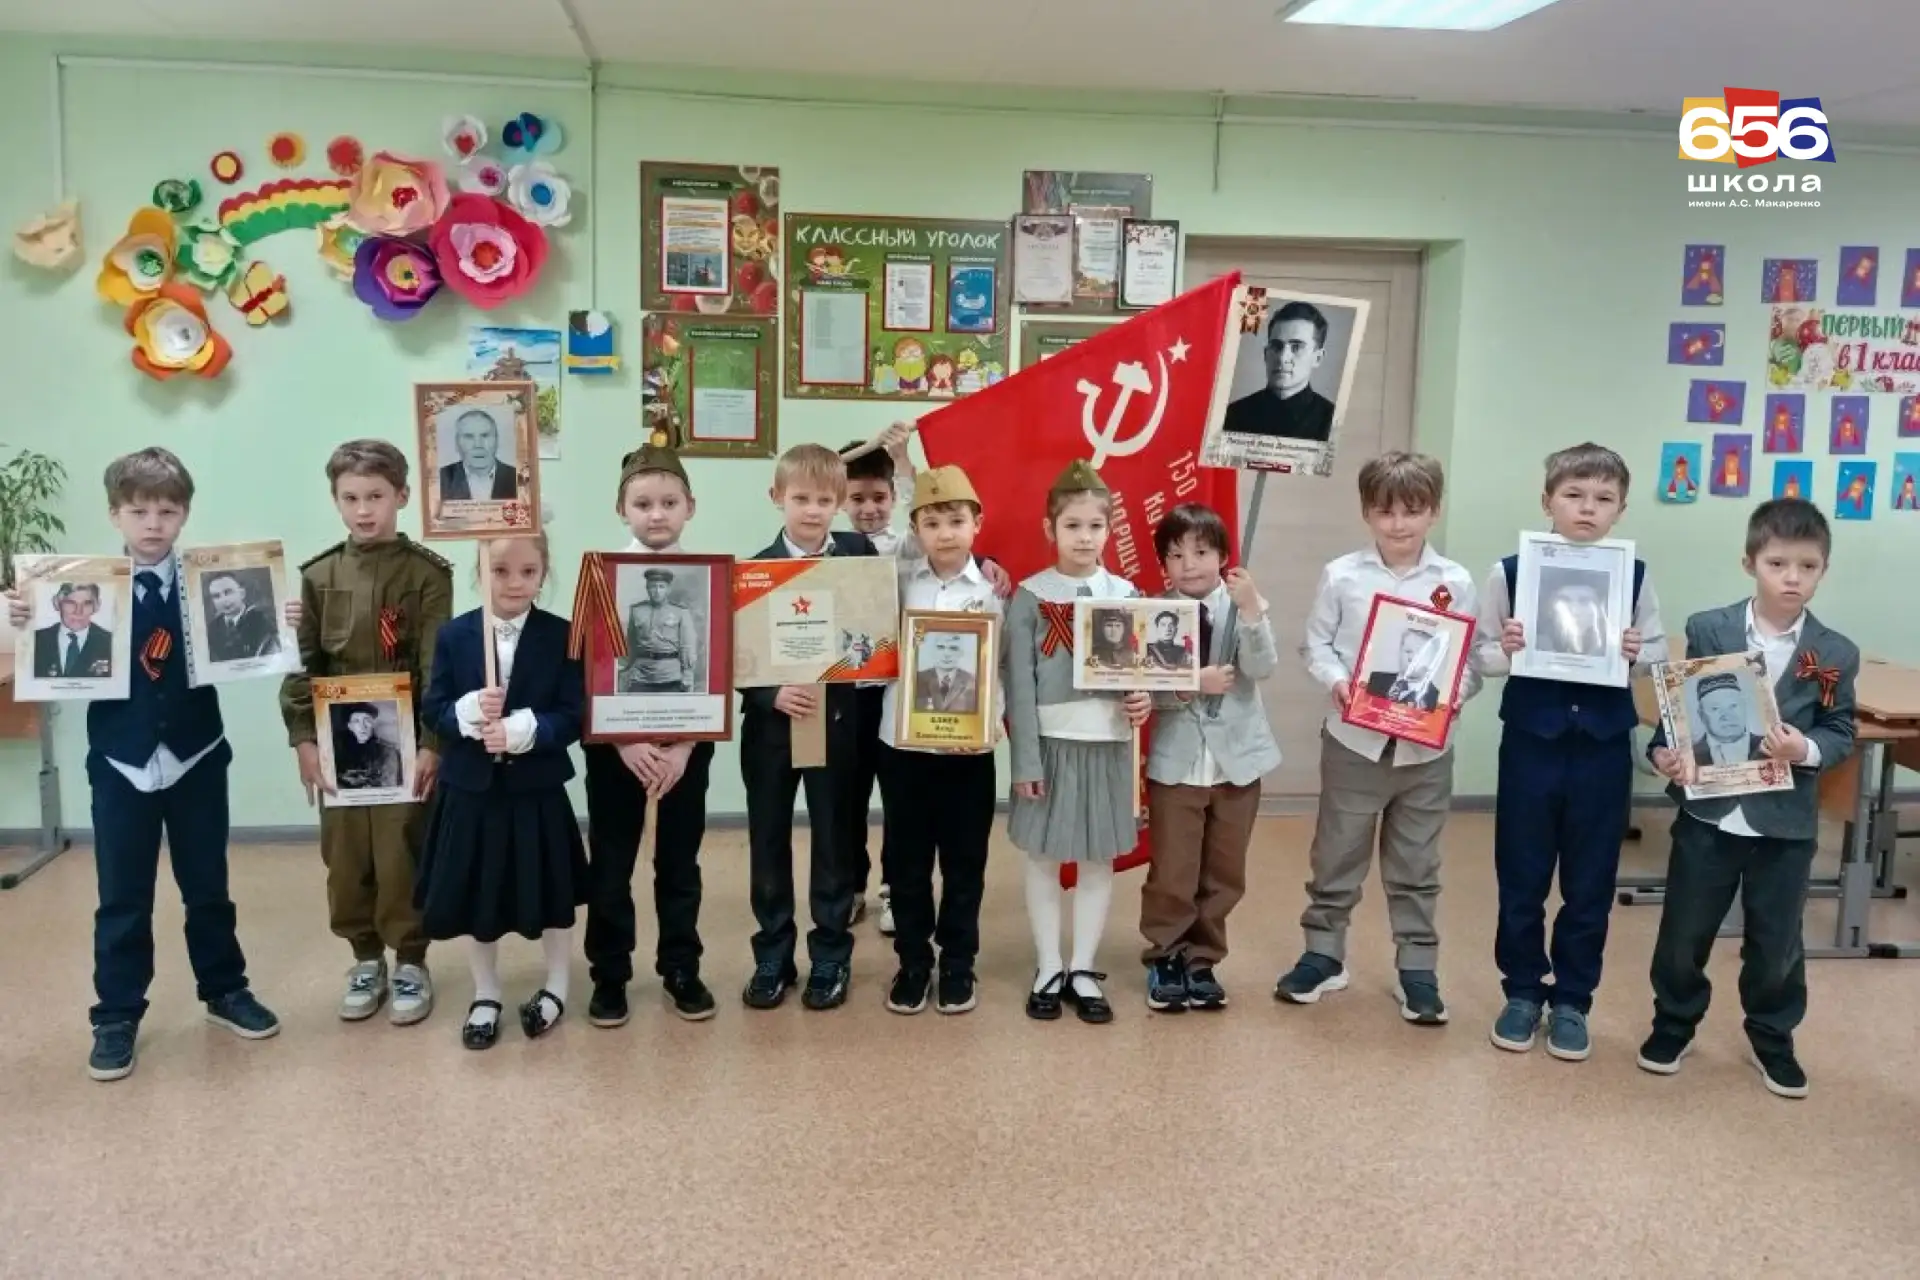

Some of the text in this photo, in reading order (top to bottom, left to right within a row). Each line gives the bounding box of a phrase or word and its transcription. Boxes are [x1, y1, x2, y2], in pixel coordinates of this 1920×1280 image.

[796, 225, 1000, 249] КЛАССНЫЙ УГОЛОК
[1854, 342, 1868, 371] 1
[1168, 451, 1198, 498] 150
